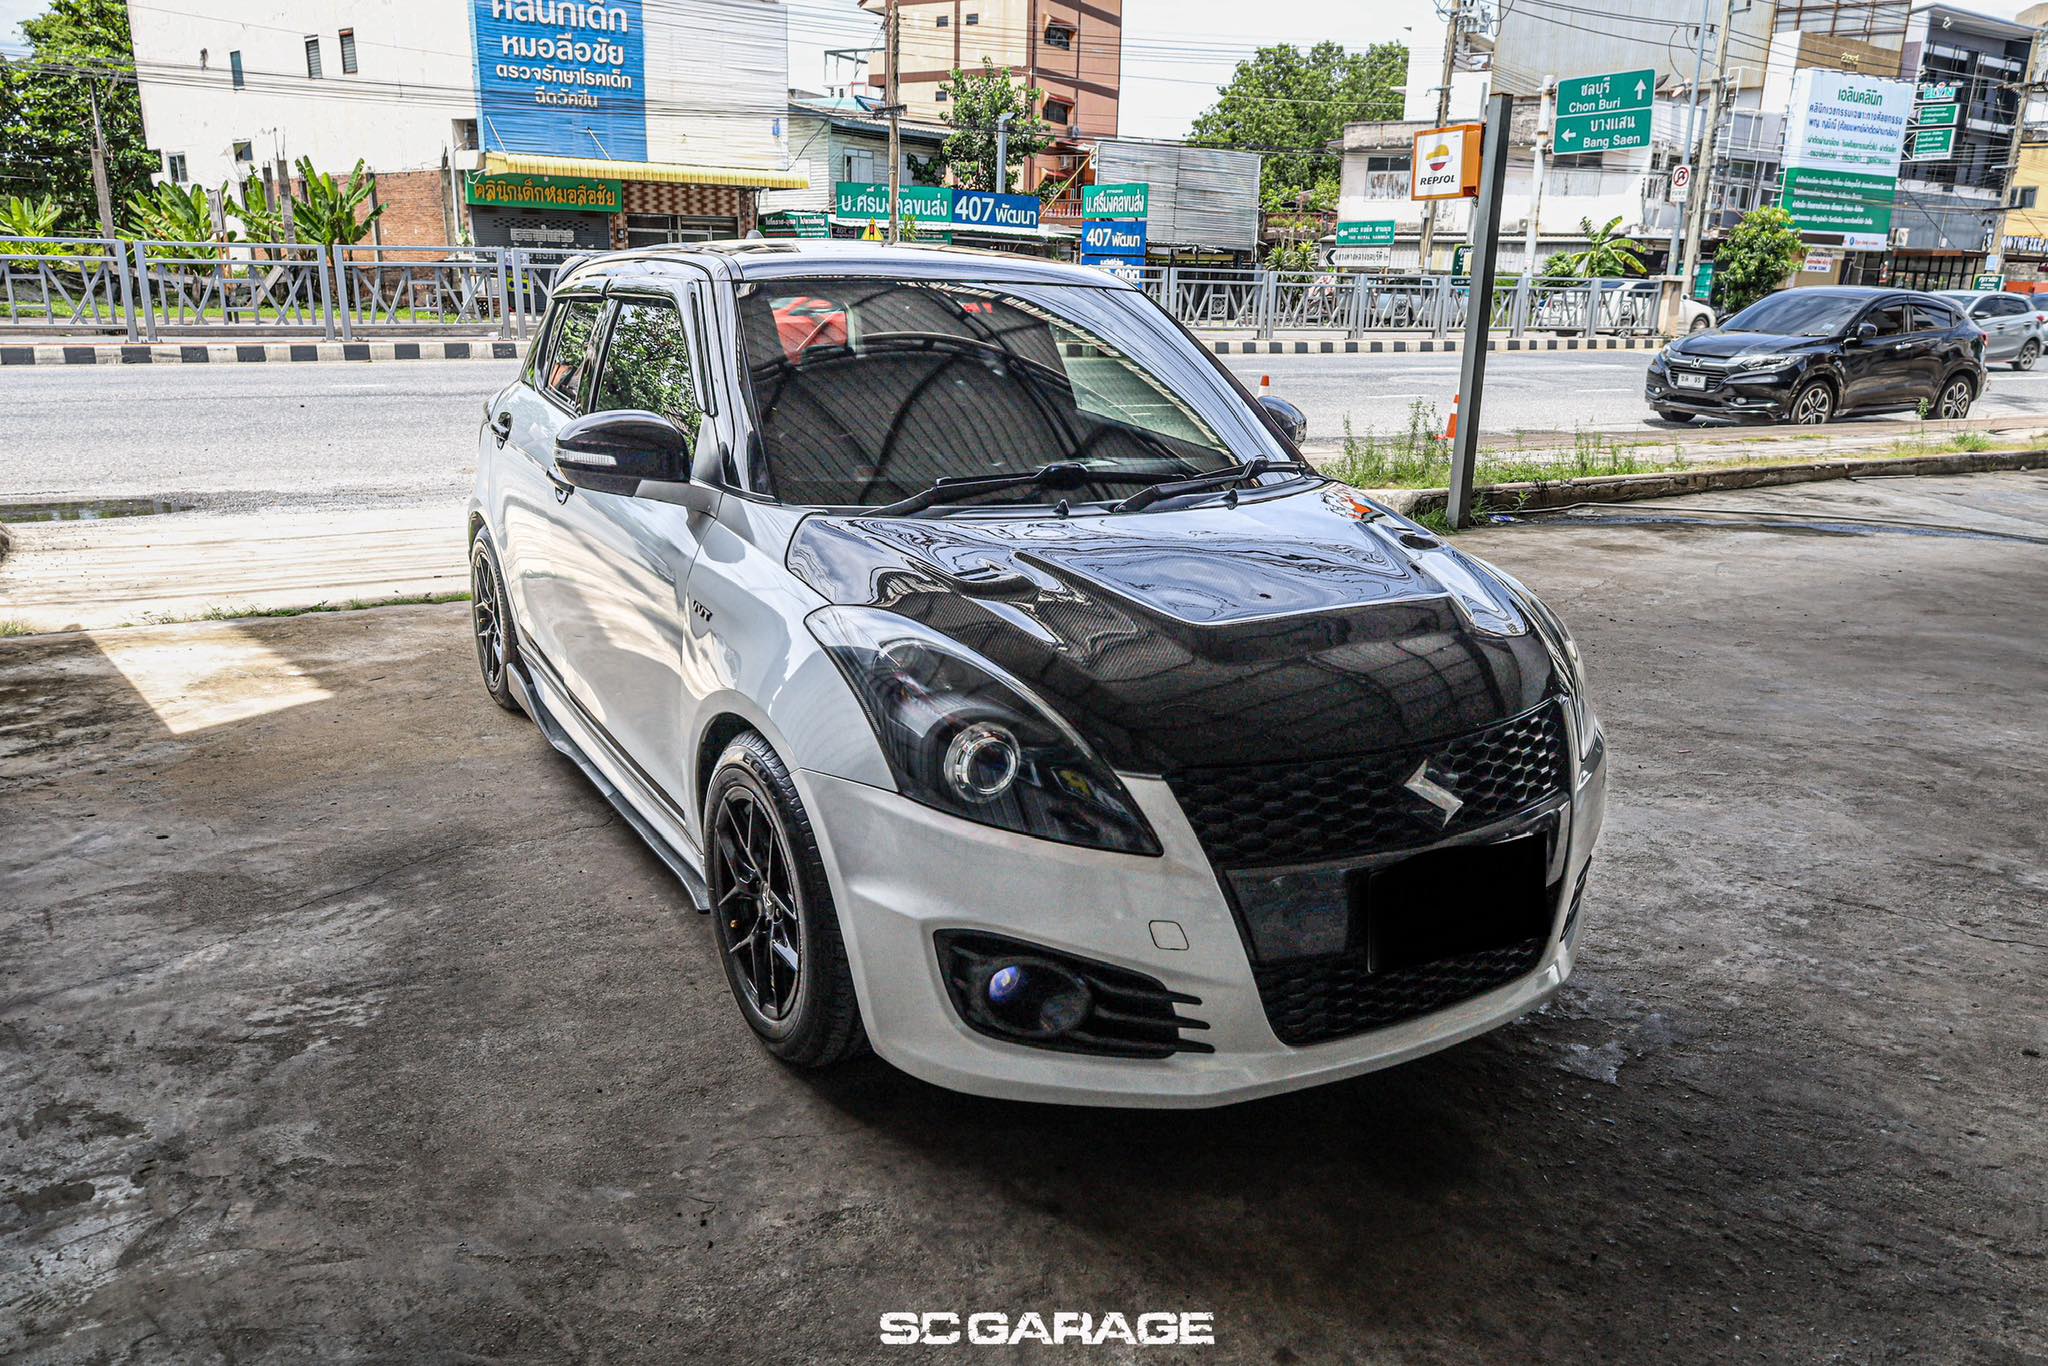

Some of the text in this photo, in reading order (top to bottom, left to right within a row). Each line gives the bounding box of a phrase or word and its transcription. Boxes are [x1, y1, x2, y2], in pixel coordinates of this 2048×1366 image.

[501, 32, 624, 66] หมอลือชัย
[496, 64, 632, 89] ตรวจรักษาโรคเด็ก
[535, 86, 599, 108] ฉีดวัคซีน
[1580, 77, 1610, 98] ชลบุรี
[1838, 86, 1883, 106] เอลินคลินิก
[1568, 97, 1620, 113] Chon Buri
[1590, 115, 1636, 132] บางแสน
[1583, 134, 1640, 149] Bang Saen
[1420, 174, 1455, 186] REPSOL
[474, 178, 616, 207] คลินิกเด็กหมอลือชัย
[954, 195, 1037, 226] 407 พัฒนา
[1086, 228, 1140, 248] 407 พัฒนา
